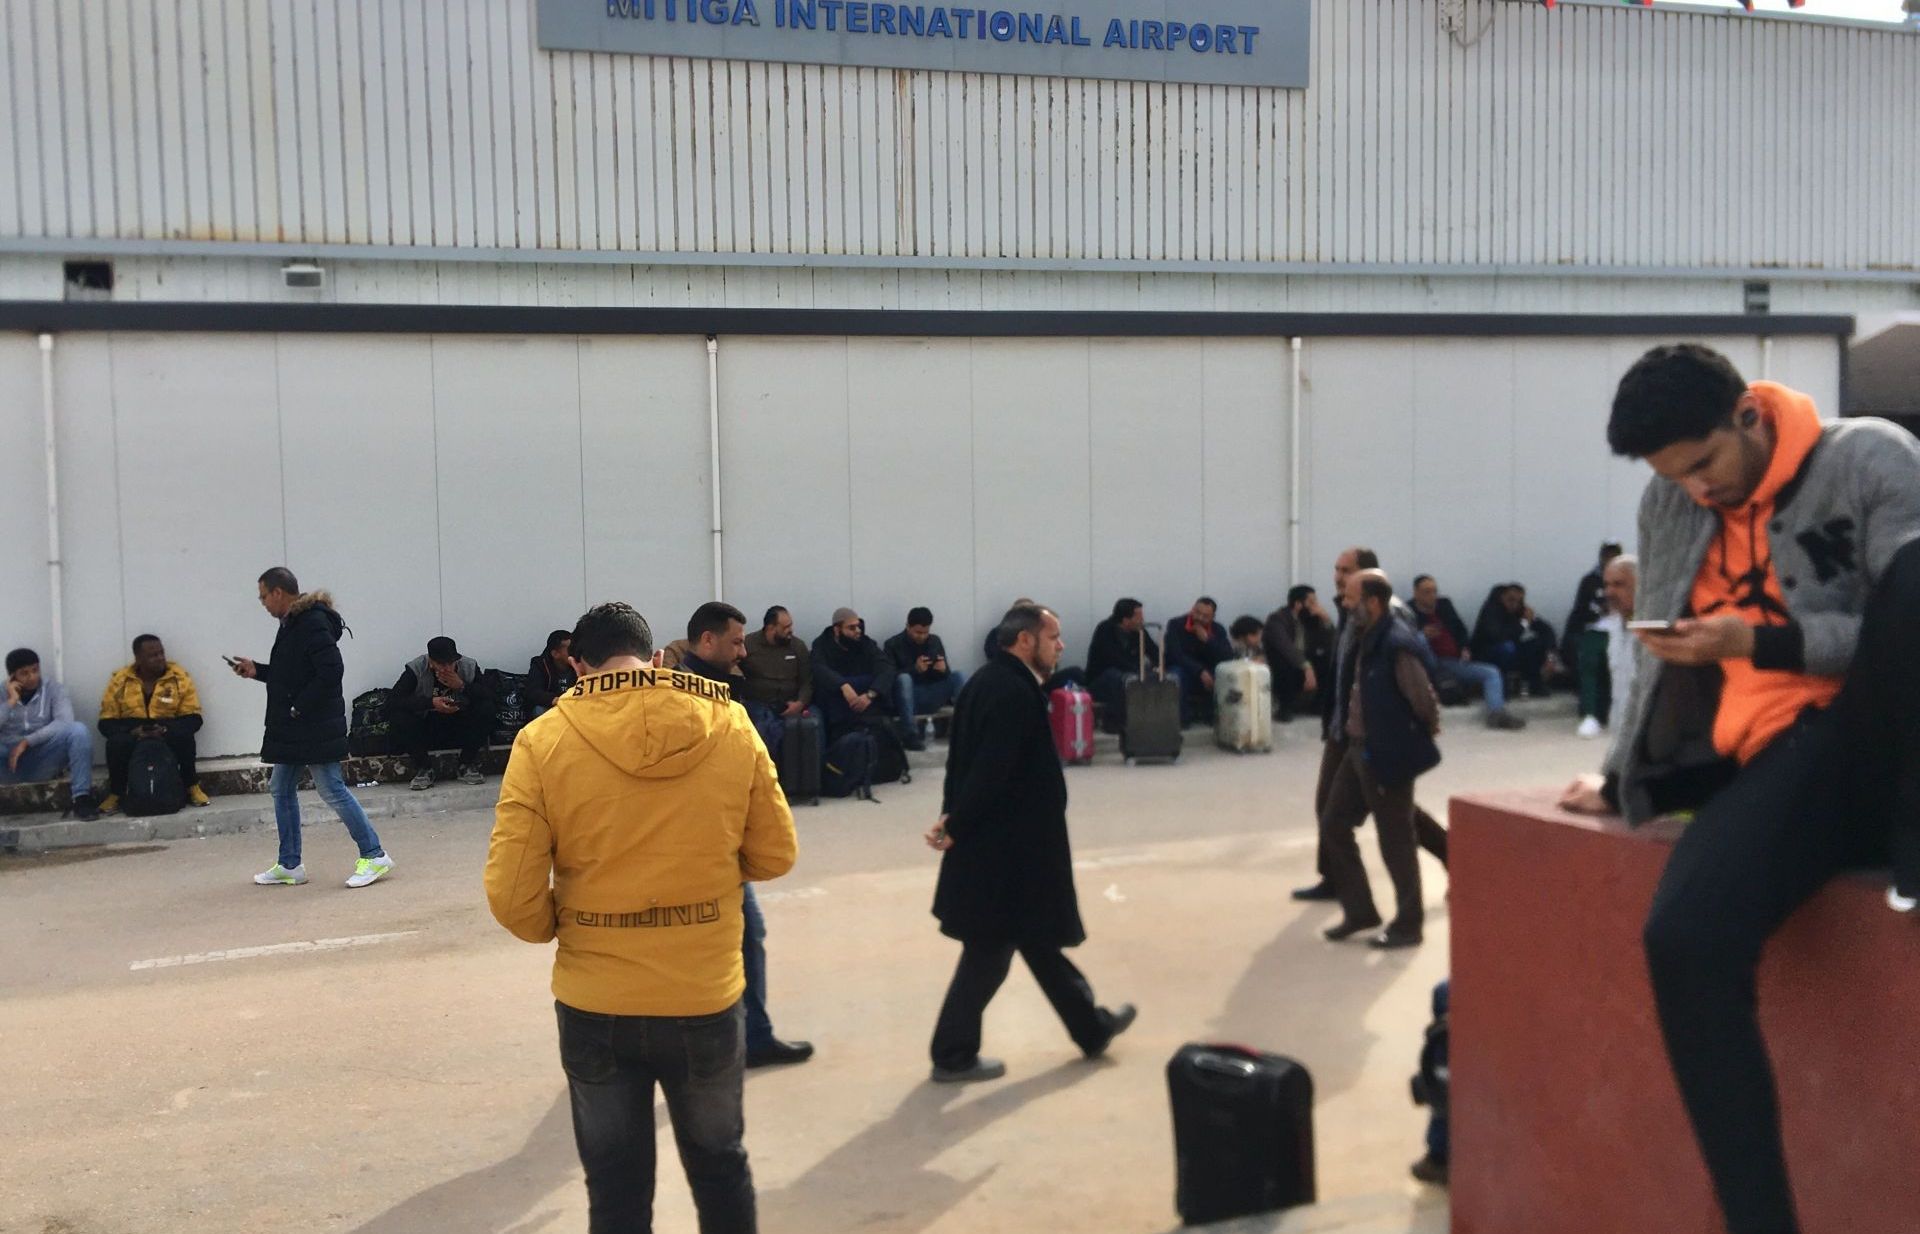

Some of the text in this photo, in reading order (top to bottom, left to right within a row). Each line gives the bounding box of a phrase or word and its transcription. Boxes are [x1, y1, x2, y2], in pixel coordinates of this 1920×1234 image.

[606, 0, 1260, 54] MITIGA INTERNATIONAL AIRPORT
